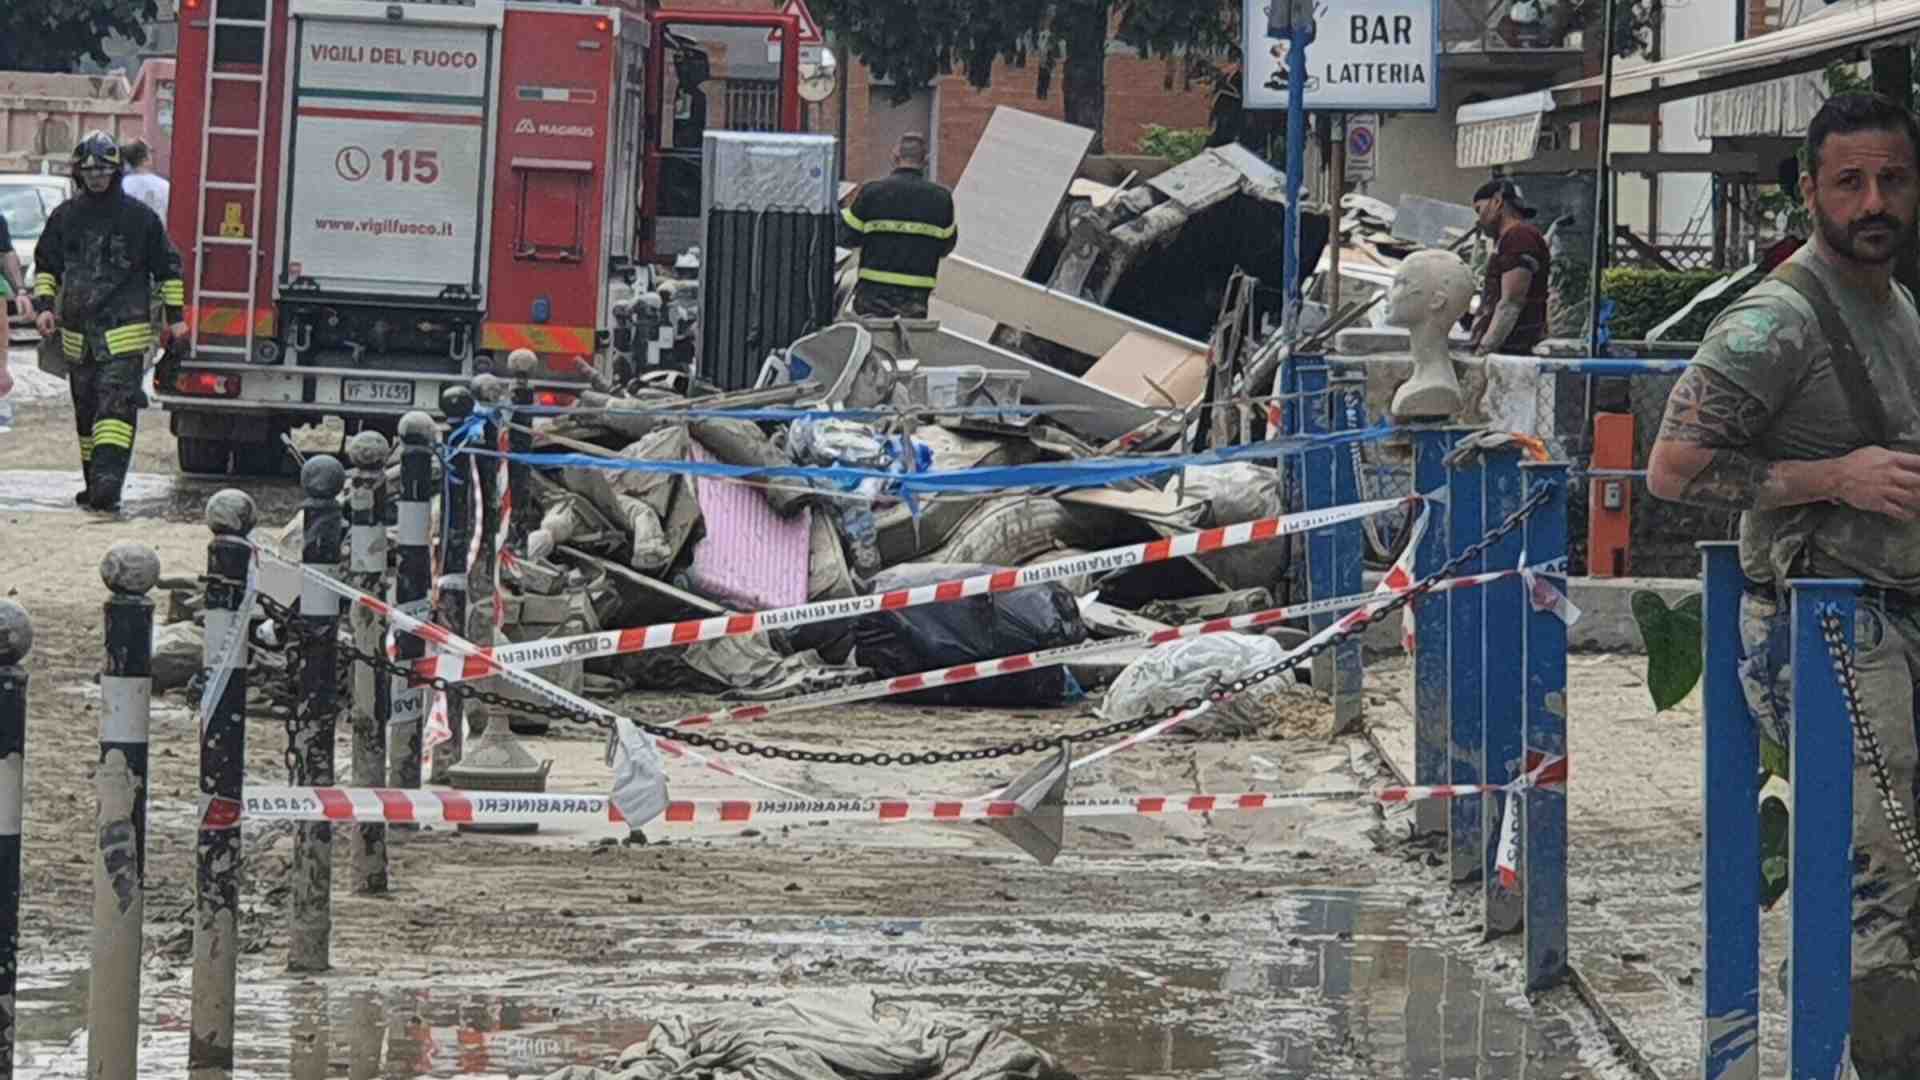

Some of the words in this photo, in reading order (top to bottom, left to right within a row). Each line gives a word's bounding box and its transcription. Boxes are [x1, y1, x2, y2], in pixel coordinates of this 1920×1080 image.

[1350, 15, 1413, 45] BAR
[310, 44, 364, 63] VIGILI
[369, 47, 407, 65] DEL
[412, 50, 478, 69] FUOCO
[1326, 63, 1426, 84] LATTERIA
[381, 148, 440, 184] 115
[314, 216, 454, 237] www.vigilfuoco.it
